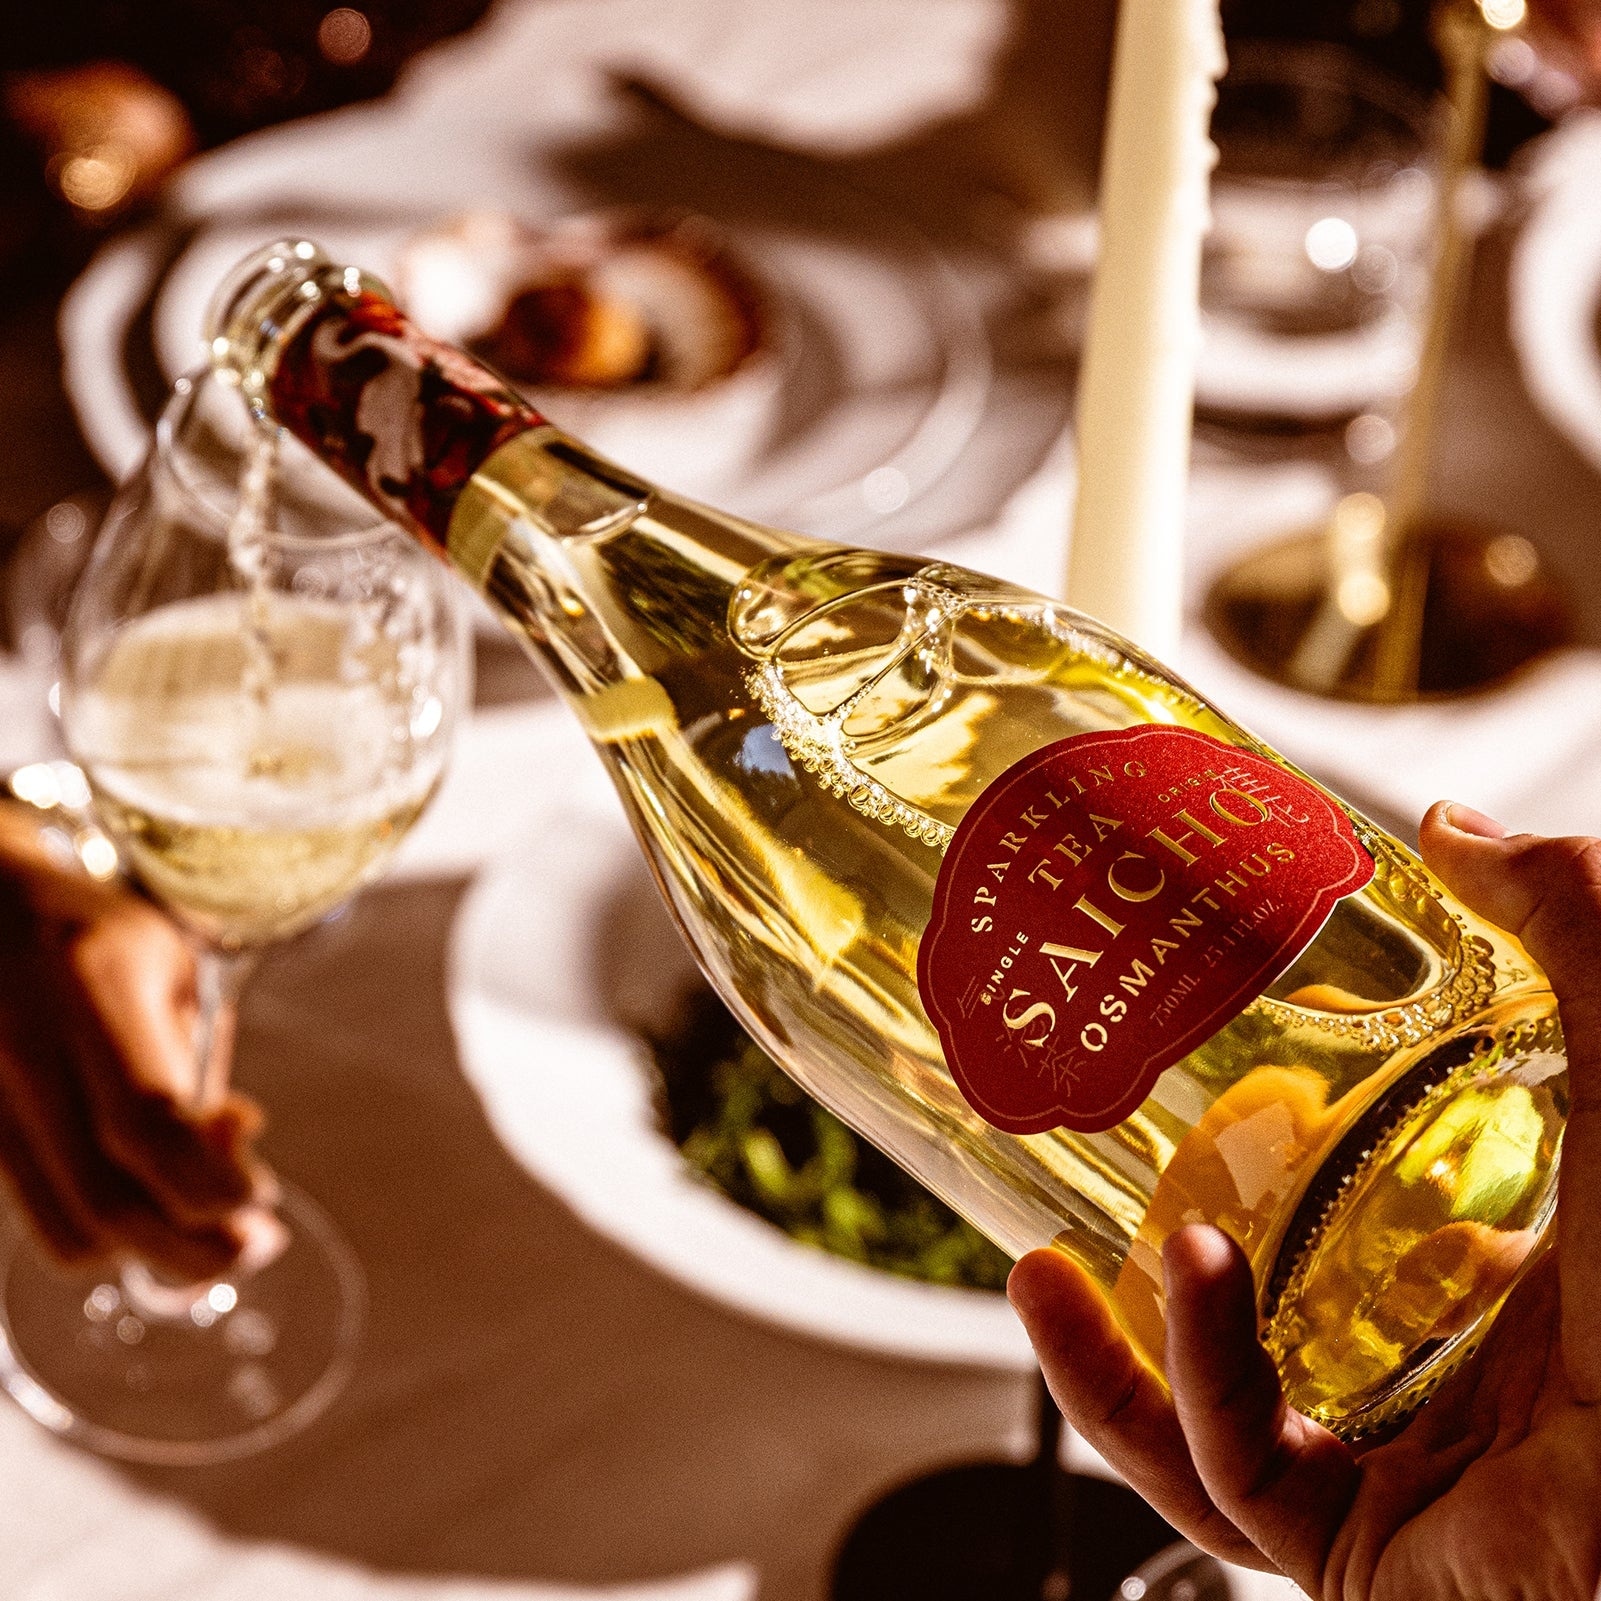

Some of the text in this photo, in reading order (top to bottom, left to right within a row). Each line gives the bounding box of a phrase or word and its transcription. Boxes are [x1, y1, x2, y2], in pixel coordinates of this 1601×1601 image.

[970, 760, 1147, 933] SPARKLING
[1027, 813, 1124, 891] TEA
[980, 931, 1029, 1006] SINGLE
[1002, 787, 1269, 1048] SAICHO
[1080, 842, 1295, 1052] OSMANTHUS
[1149, 974, 1201, 1028] 750ML
